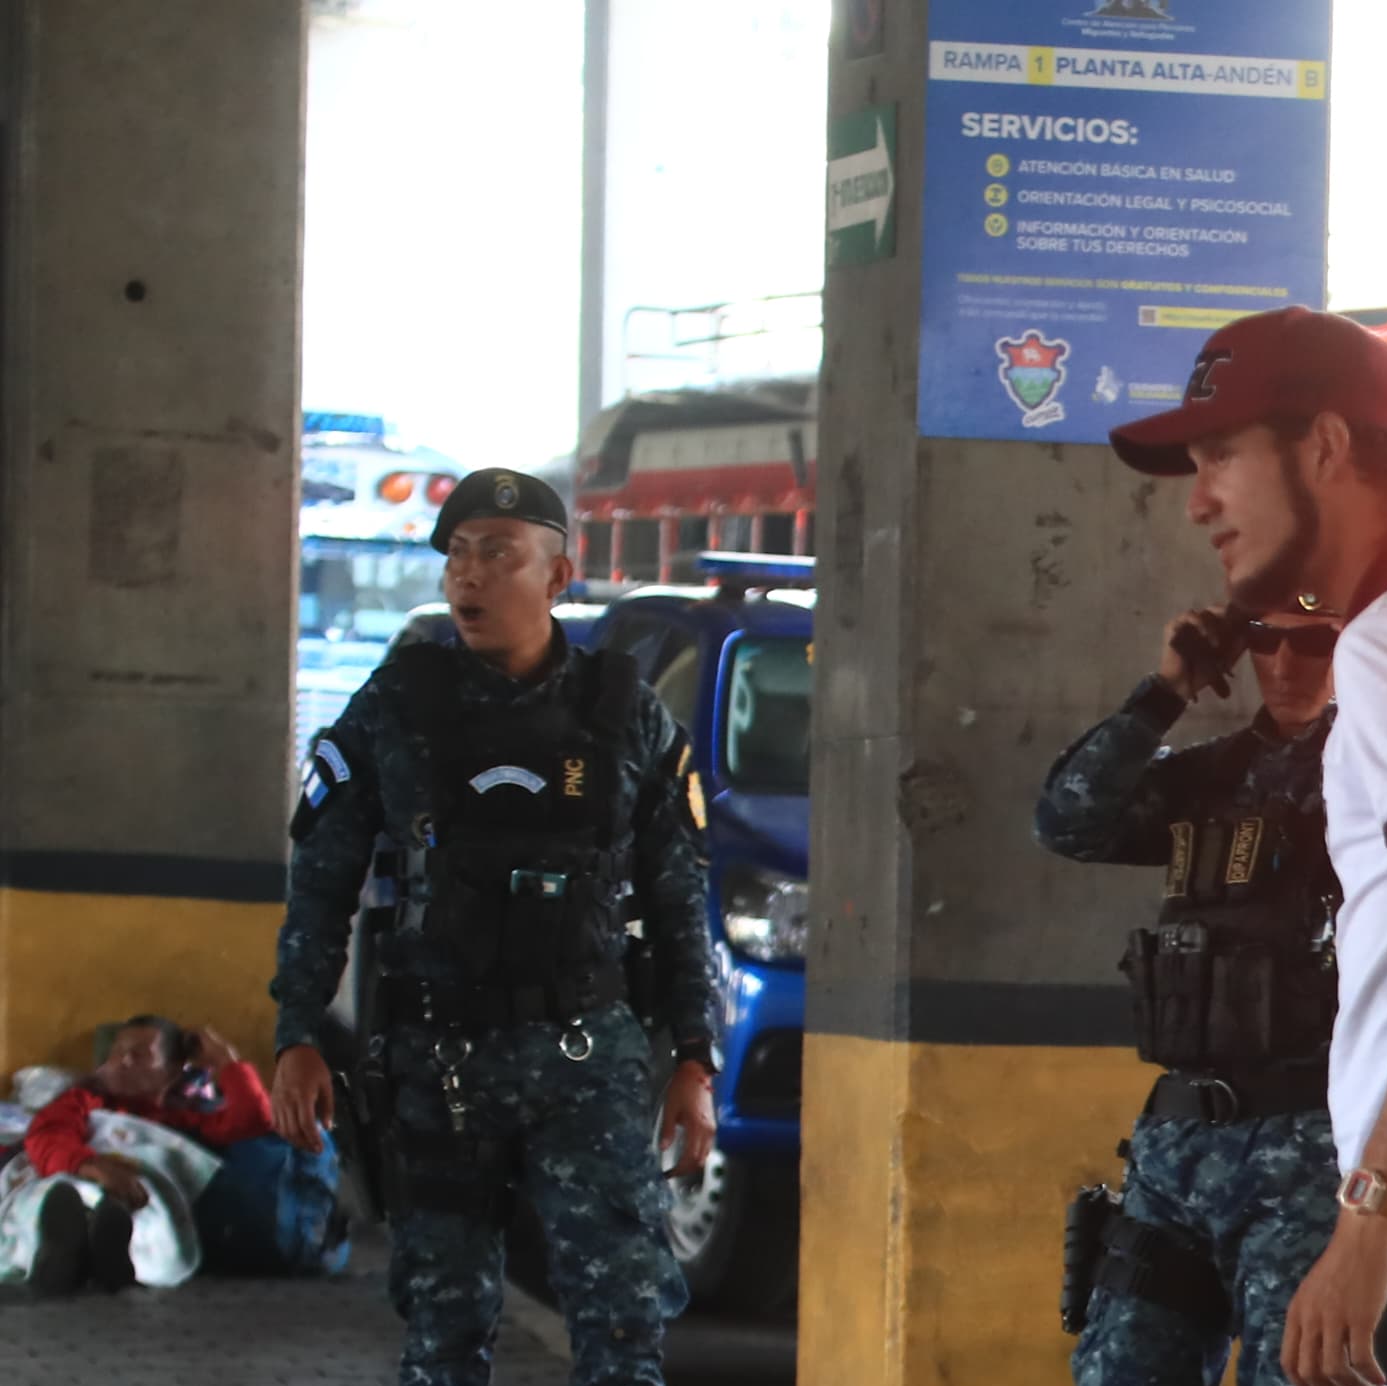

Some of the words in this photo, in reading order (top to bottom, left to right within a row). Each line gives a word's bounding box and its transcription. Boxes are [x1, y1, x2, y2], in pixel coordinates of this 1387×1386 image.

[943, 50, 1022, 72] RAMPA
[1034, 55, 1043, 73] 1
[1056, 57, 1145, 78] PLANTA
[1305, 70, 1319, 88] B
[961, 112, 1138, 145] SERVICIOS:
[1018, 158, 1097, 177] ATENCIÓN
[1160, 167, 1181, 181] EN
[1184, 167, 1236, 184] SALUD
[1017, 188, 1122, 208] ORIENTACIÓN
[1125, 195, 1172, 210] LEGAL
[1177, 199, 1188, 210] Y
[1191, 199, 1292, 217] PSICOSOCIAL
[1017, 220, 1126, 238] INFORMACIÓN
[1130, 226, 1141, 238] Y
[1144, 225, 1248, 244] ORIENTACIÓN
[1017, 236, 1067, 251] SOBRE
[1072, 239, 1101, 252] TUS
[1106, 240, 1190, 257] DERECHOS
[564, 759, 585, 797] PNC
